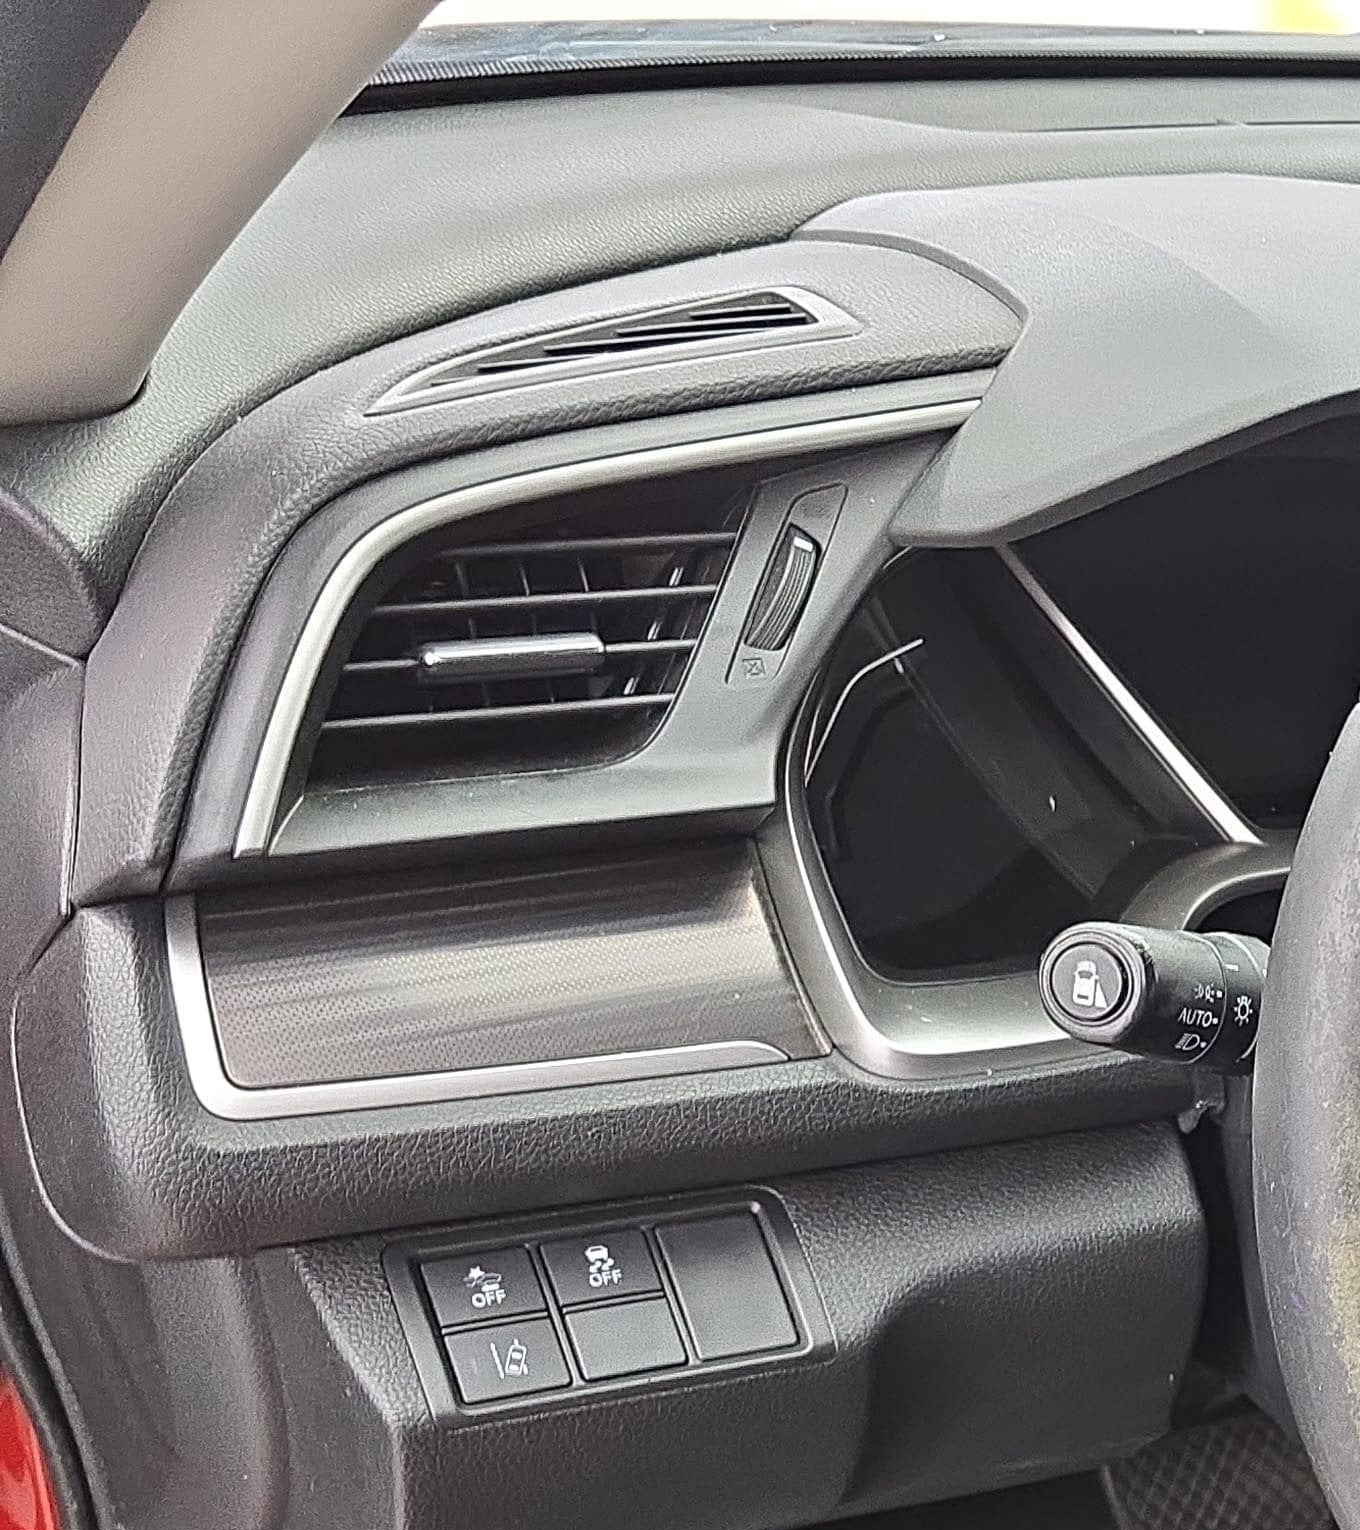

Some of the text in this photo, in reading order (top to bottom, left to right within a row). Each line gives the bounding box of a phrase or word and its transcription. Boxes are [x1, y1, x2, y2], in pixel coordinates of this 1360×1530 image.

[1178, 1007, 1213, 1028] AUTO
[588, 1268, 622, 1288] OFF
[471, 1288, 507, 1308] OFF
